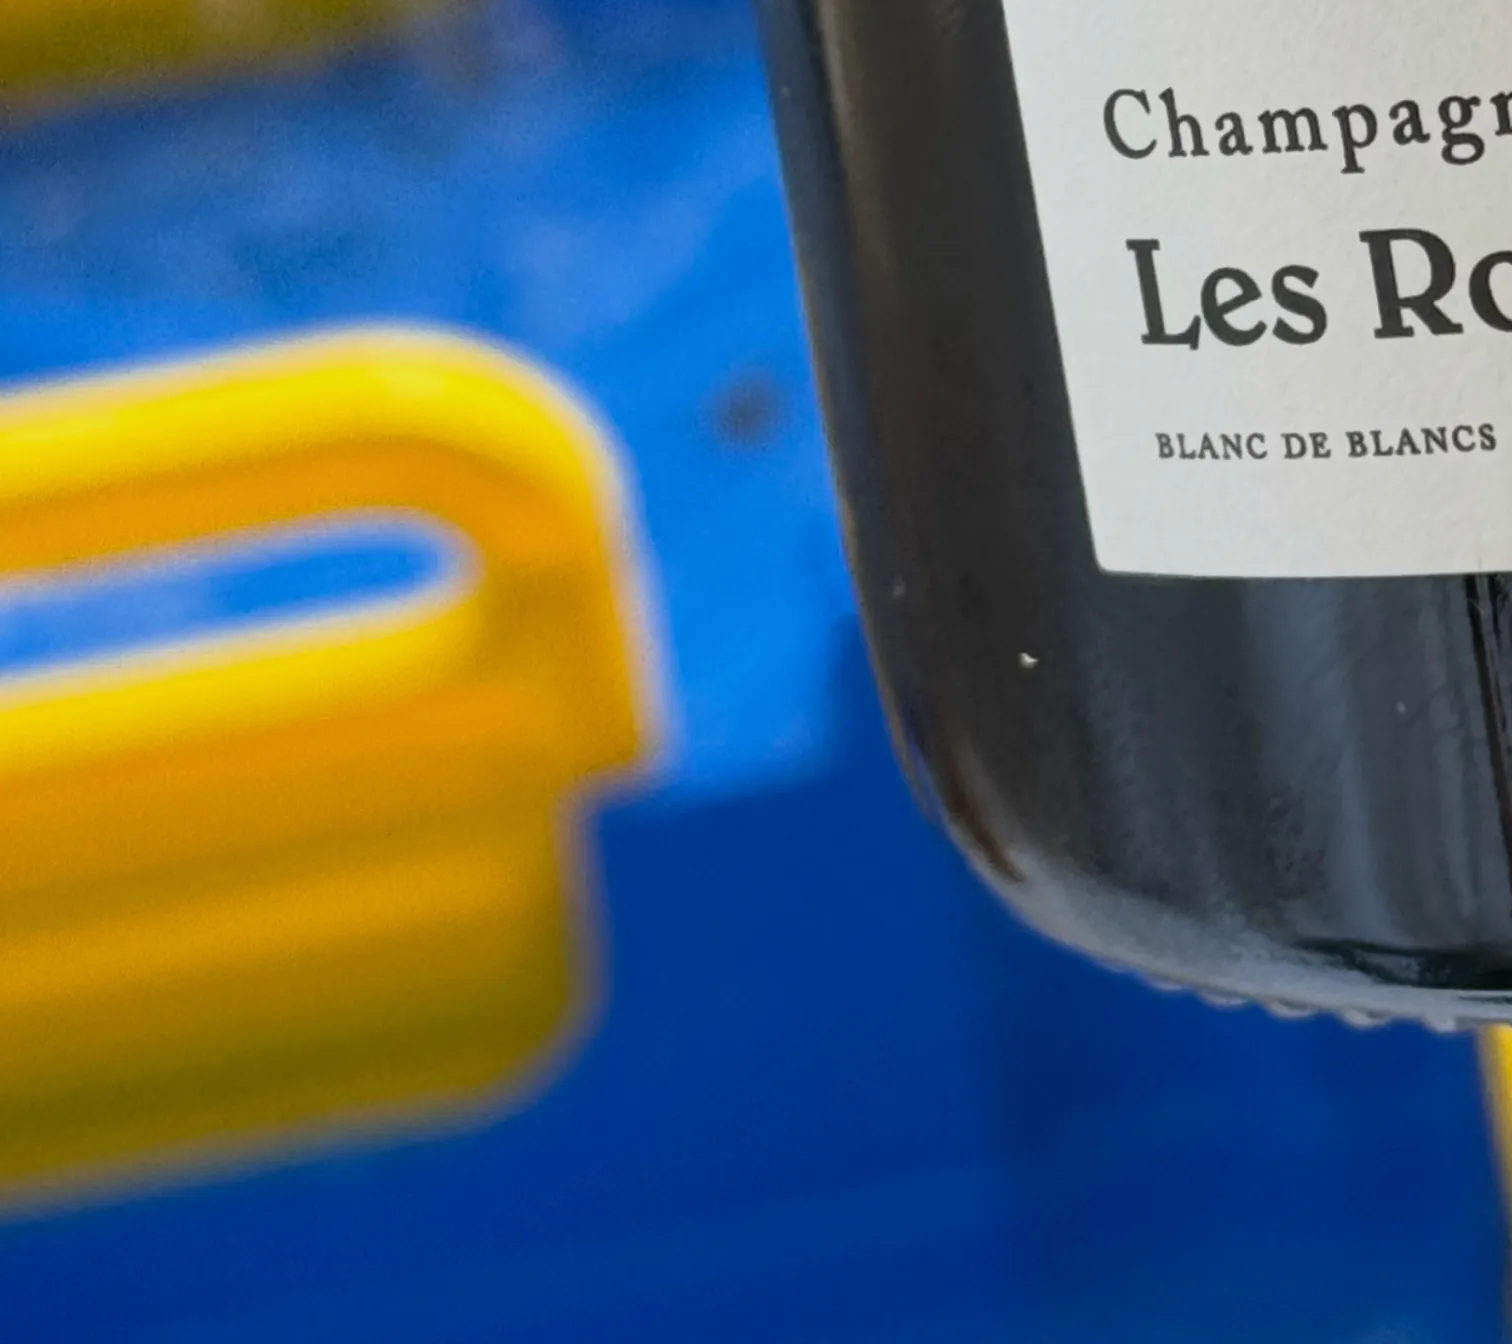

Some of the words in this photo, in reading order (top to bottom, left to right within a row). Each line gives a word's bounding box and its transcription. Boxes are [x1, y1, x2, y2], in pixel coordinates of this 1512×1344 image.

[1125, 238, 1328, 351] Les
[1156, 432, 1268, 460] BLANC
[1283, 431, 1332, 460] DE
[1345, 422, 1497, 458] BLANCS
